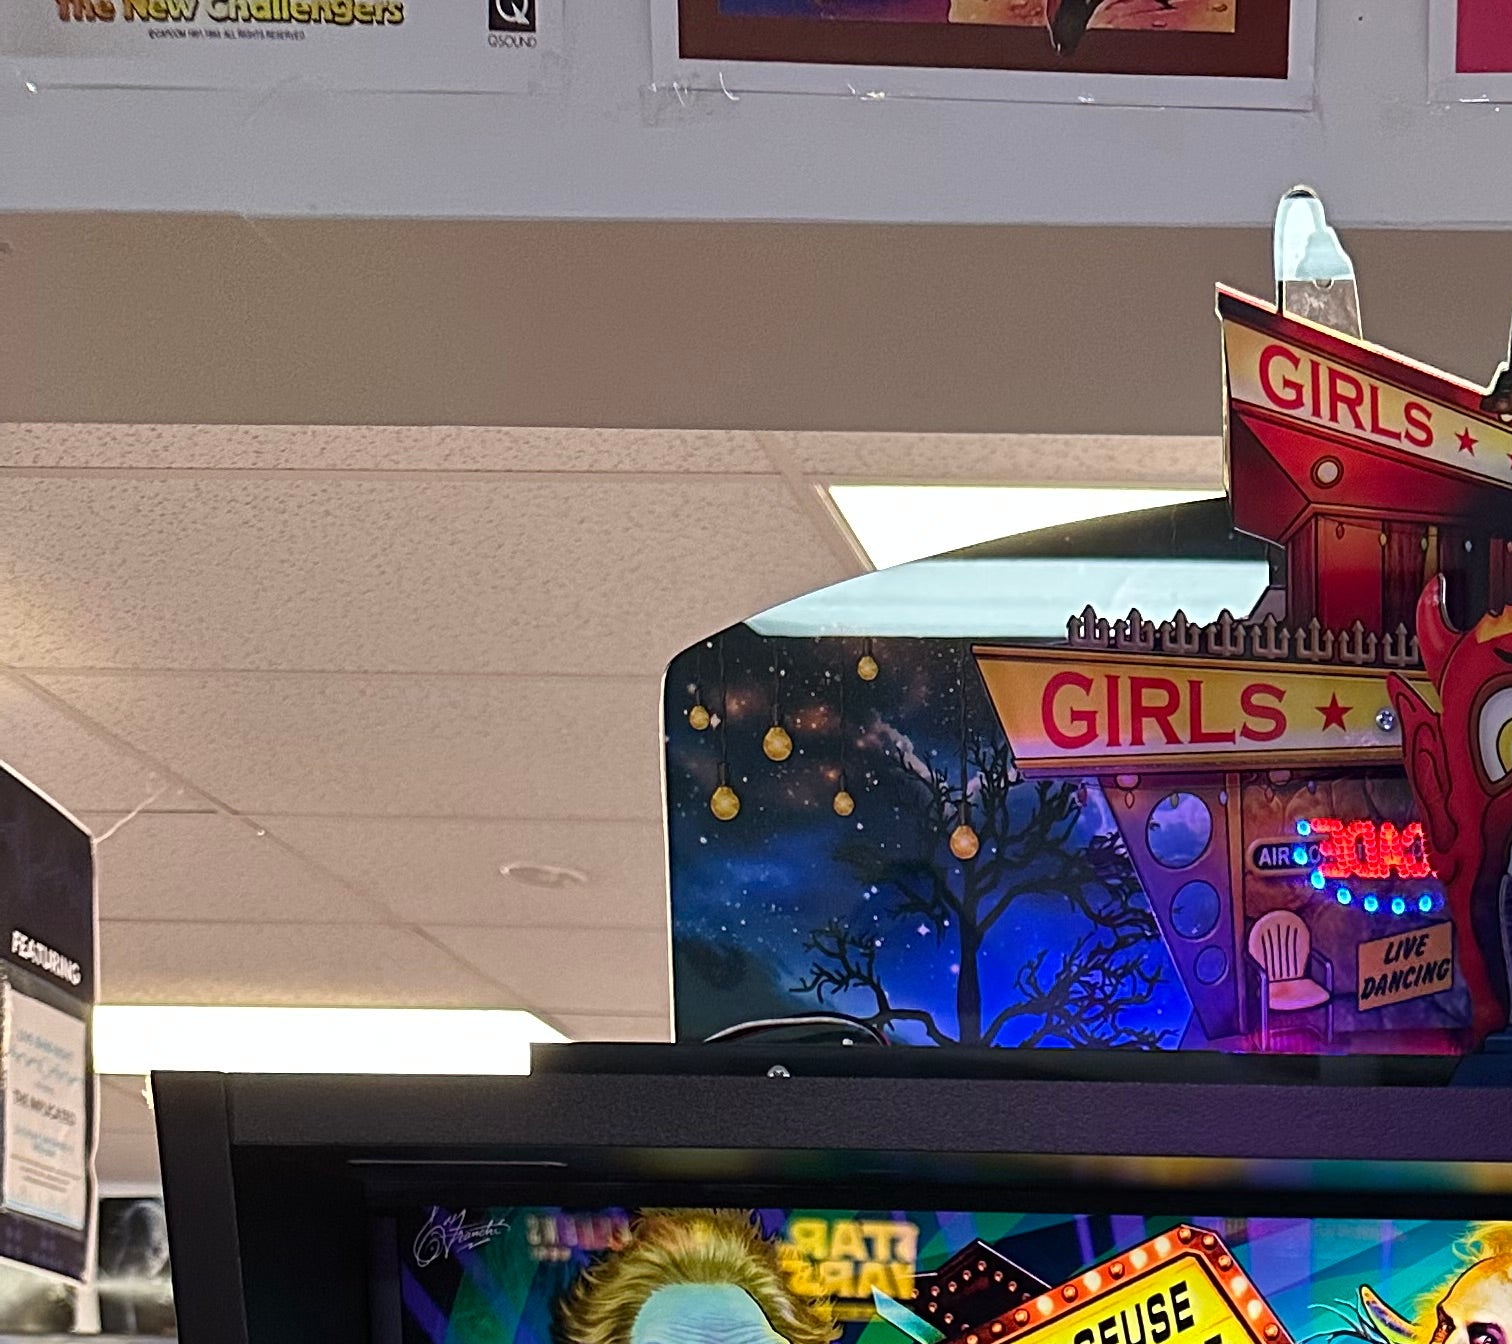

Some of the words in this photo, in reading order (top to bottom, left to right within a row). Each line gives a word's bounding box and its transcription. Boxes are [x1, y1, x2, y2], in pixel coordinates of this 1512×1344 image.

[124, 0, 198, 22] New
[206, 0, 405, 25] Challengers
[488, 34, 537, 48] QSOUND
[1259, 344, 1434, 448] GIRLS
[1041, 668, 1288, 750] GIRLS
[1258, 846, 1291, 867] AIR
[10, 929, 82, 986] FEATURING
[1383, 933, 1430, 965] LIVE
[1360, 958, 1451, 1001] DANCING
